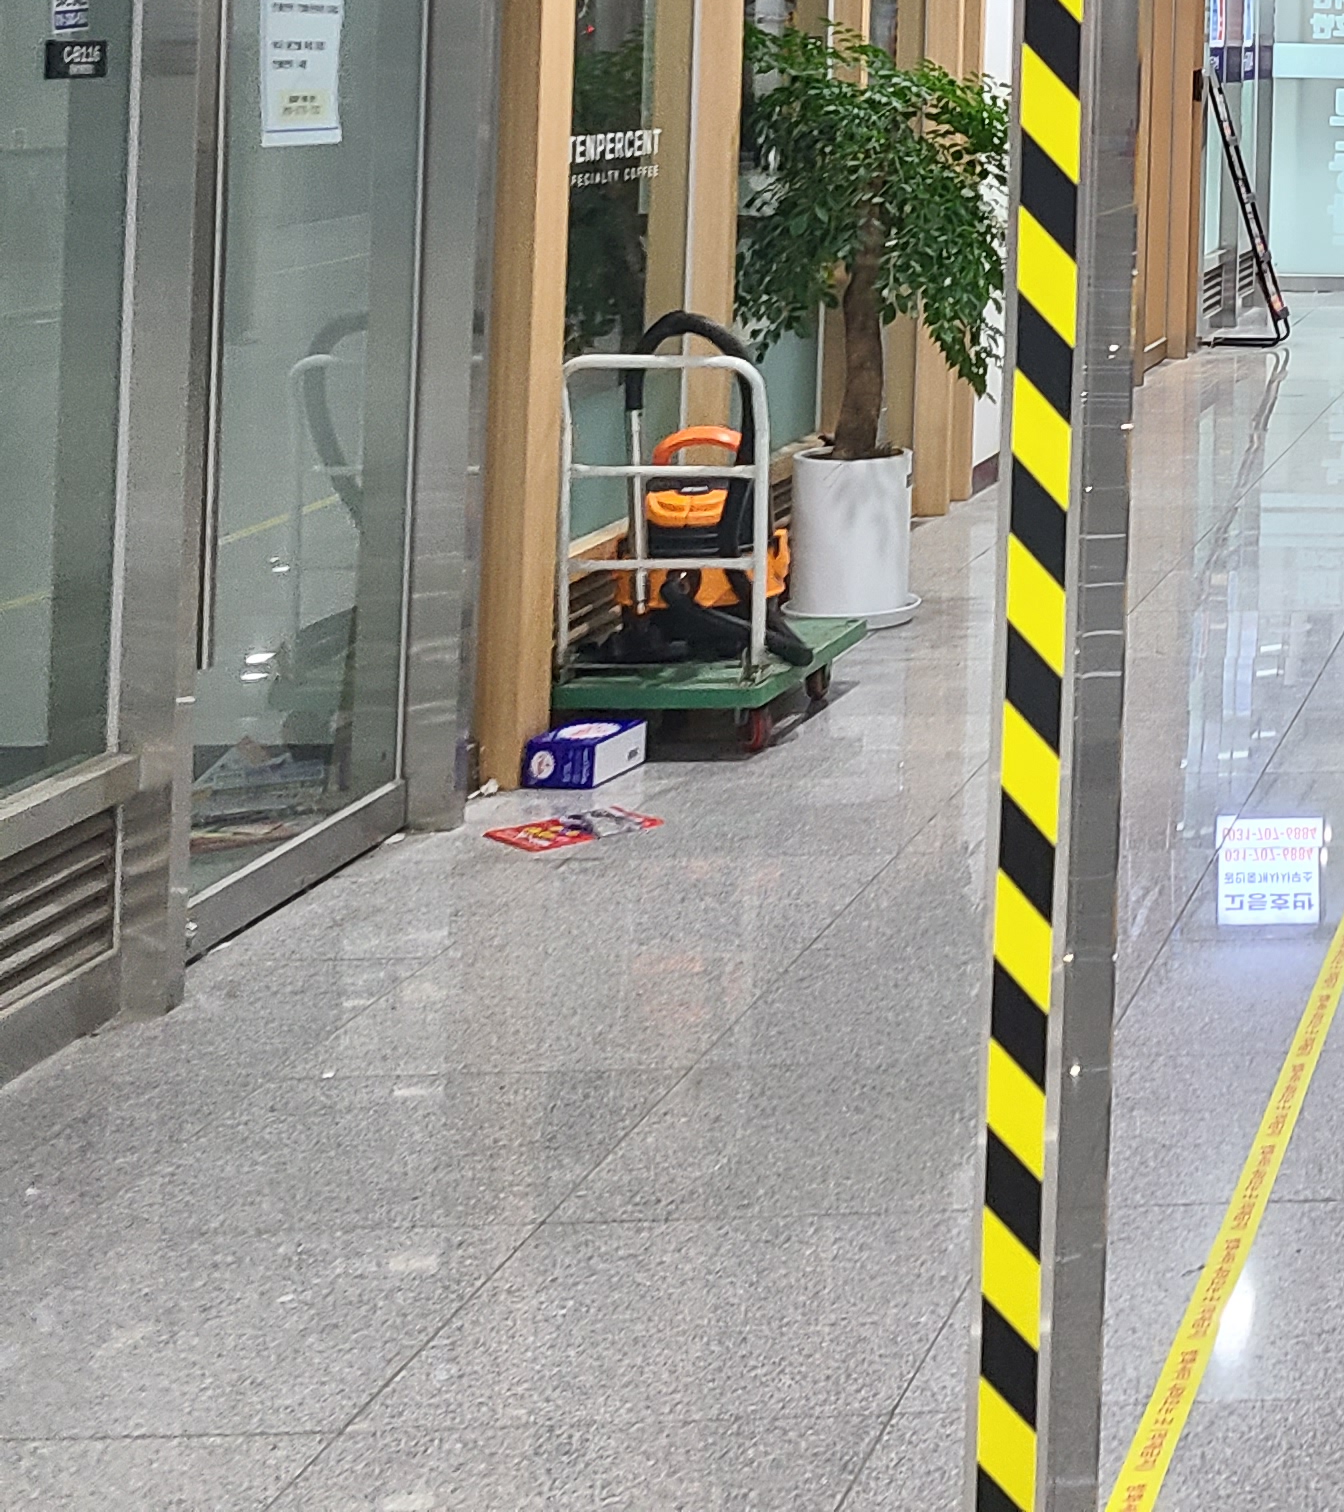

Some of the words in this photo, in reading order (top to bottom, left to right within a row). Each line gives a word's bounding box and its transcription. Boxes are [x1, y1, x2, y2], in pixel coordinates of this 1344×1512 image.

[568, 128, 663, 165] TENPERCENT
[569, 169, 620, 188] PECIALTY
[623, 164, 660, 182] COFFEE
